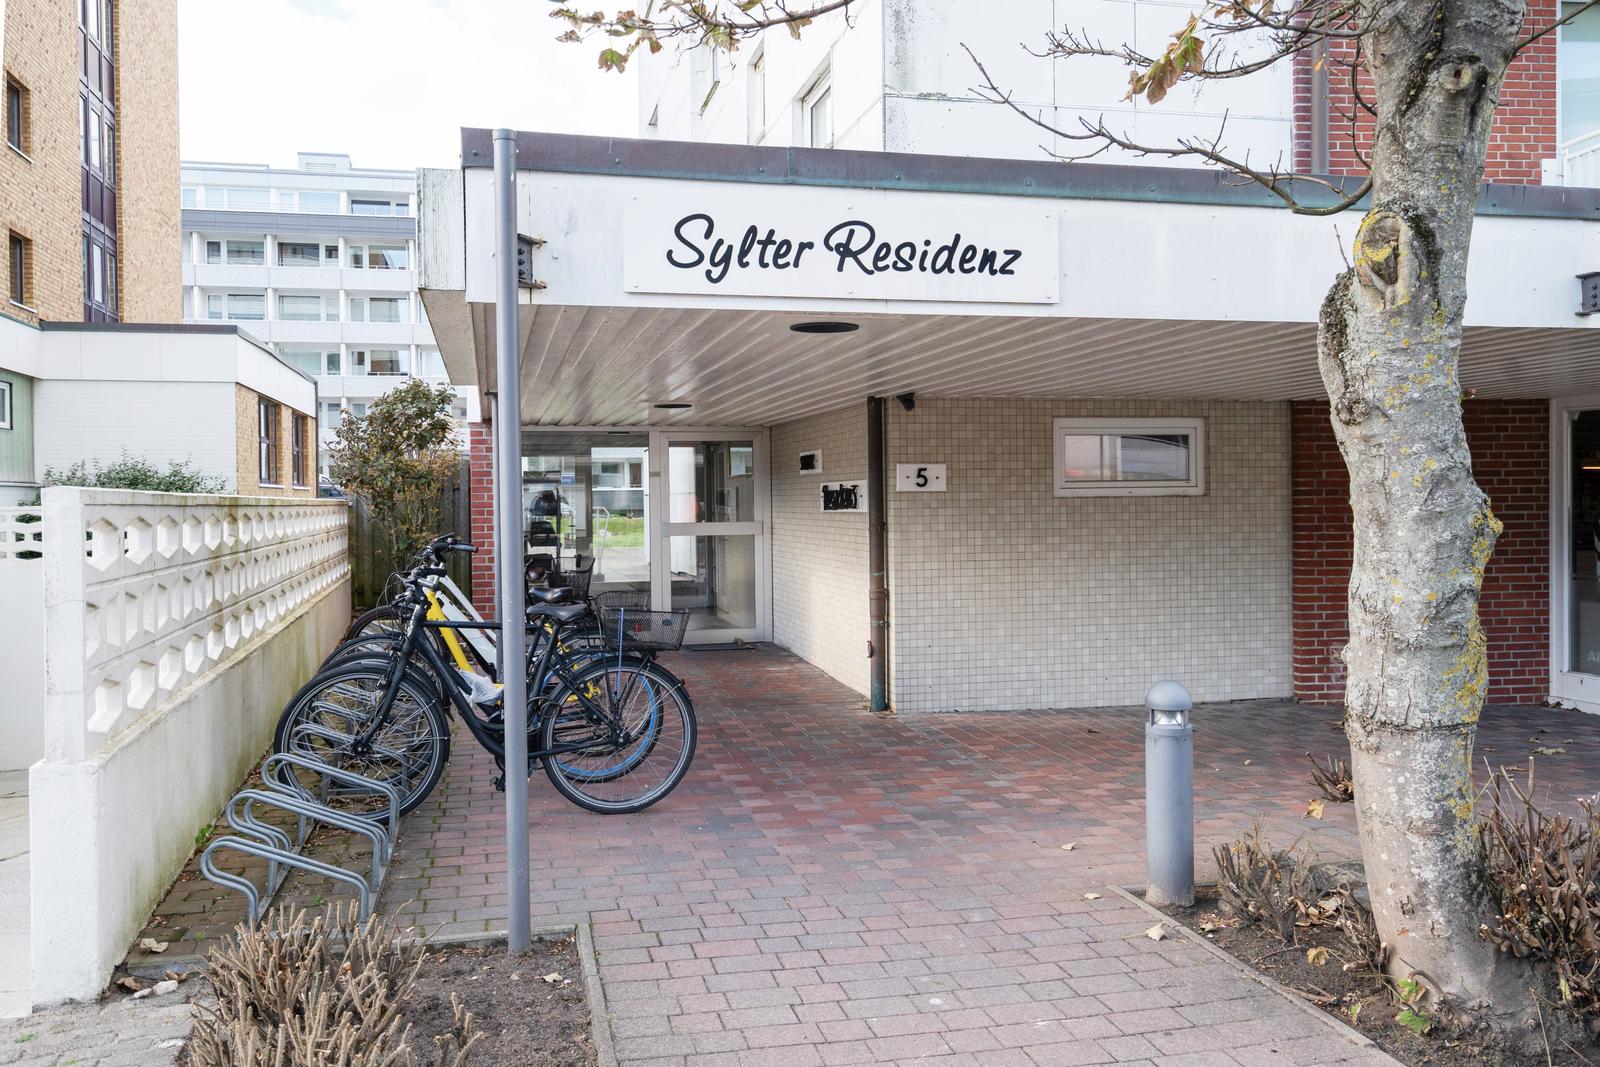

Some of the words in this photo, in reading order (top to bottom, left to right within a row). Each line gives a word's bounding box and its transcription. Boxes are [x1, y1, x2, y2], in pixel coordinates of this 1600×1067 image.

[666, 213, 814, 284] Sylter
[823, 220, 1022, 276] Residenz
[915, 467, 928, 487] 5
